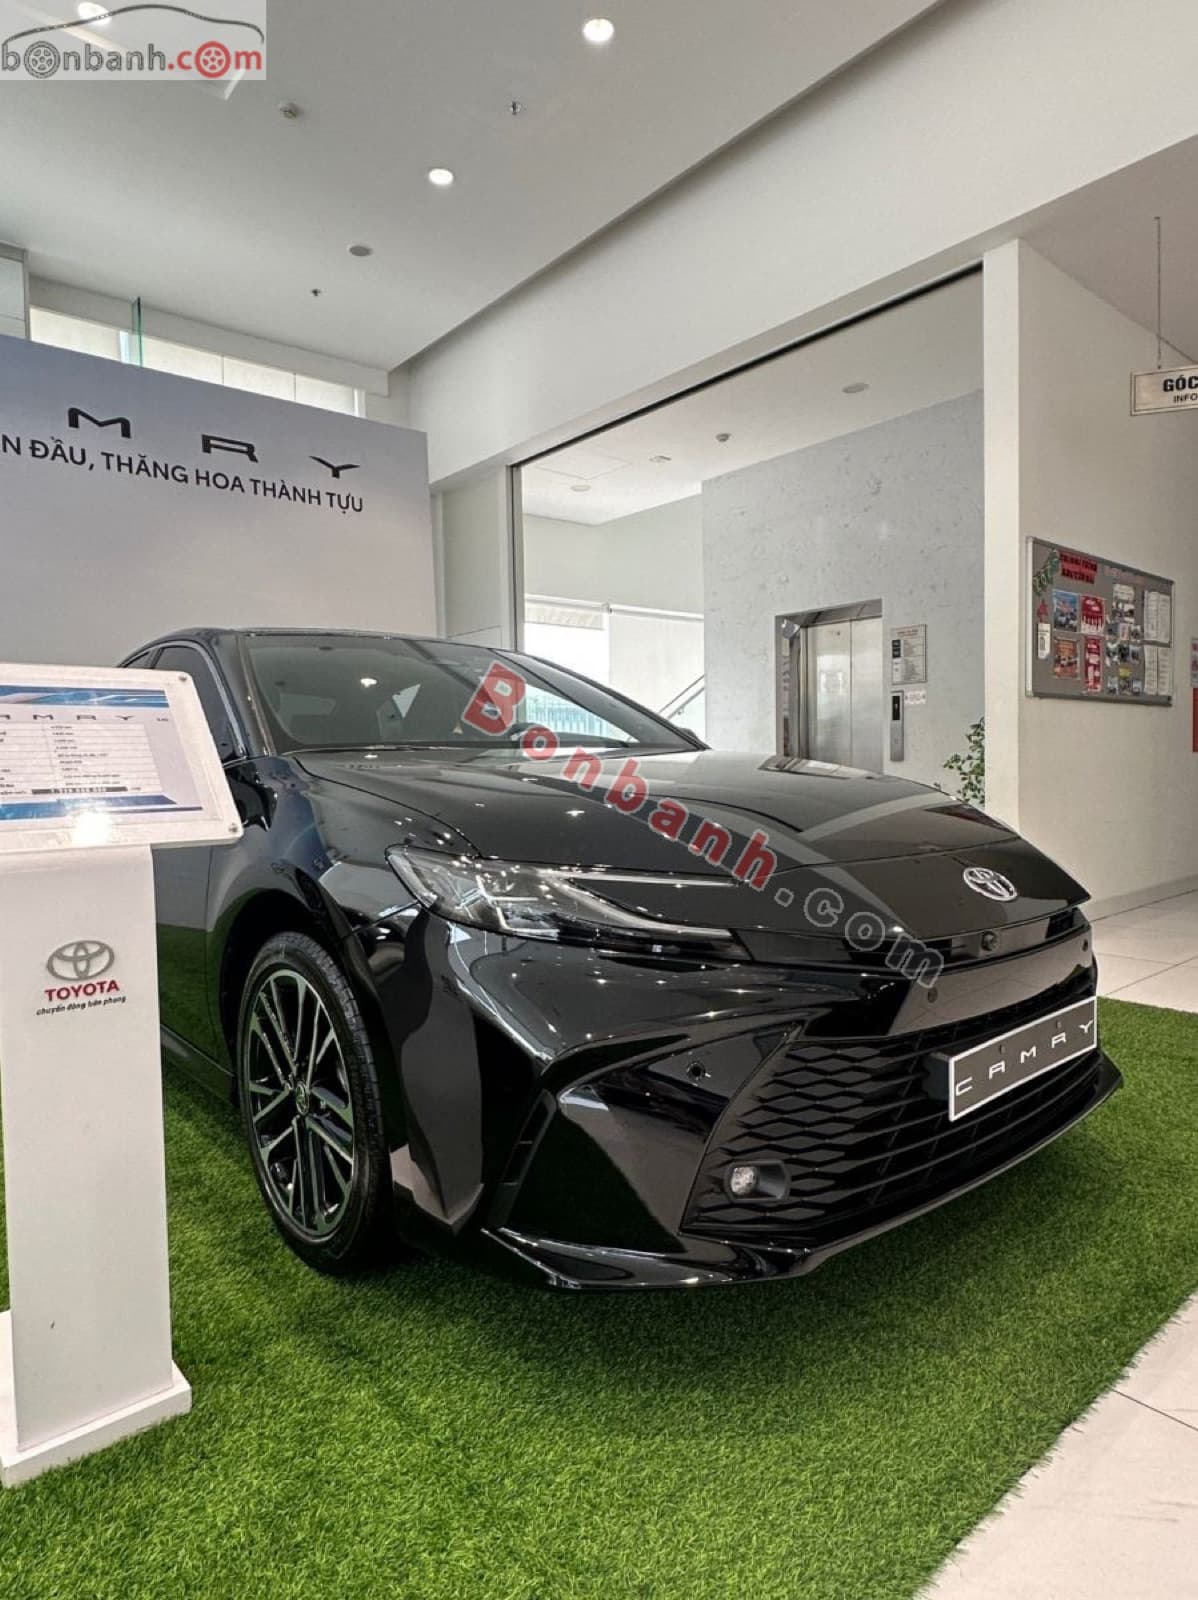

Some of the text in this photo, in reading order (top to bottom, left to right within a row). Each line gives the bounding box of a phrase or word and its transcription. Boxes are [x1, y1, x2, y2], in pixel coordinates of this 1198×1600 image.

[1163, 374, 1198, 392] GÓC
[29, 436, 94, 471] ĐẦU,
[100, 452, 189, 484] THĂNG
[195, 469, 245, 493] HOA
[249, 479, 321, 505] THÀNH
[325, 491, 363, 514] TỰU
[44, 979, 120, 1002] TOYOTA
[956, 1019, 1094, 1096] CAMRY
